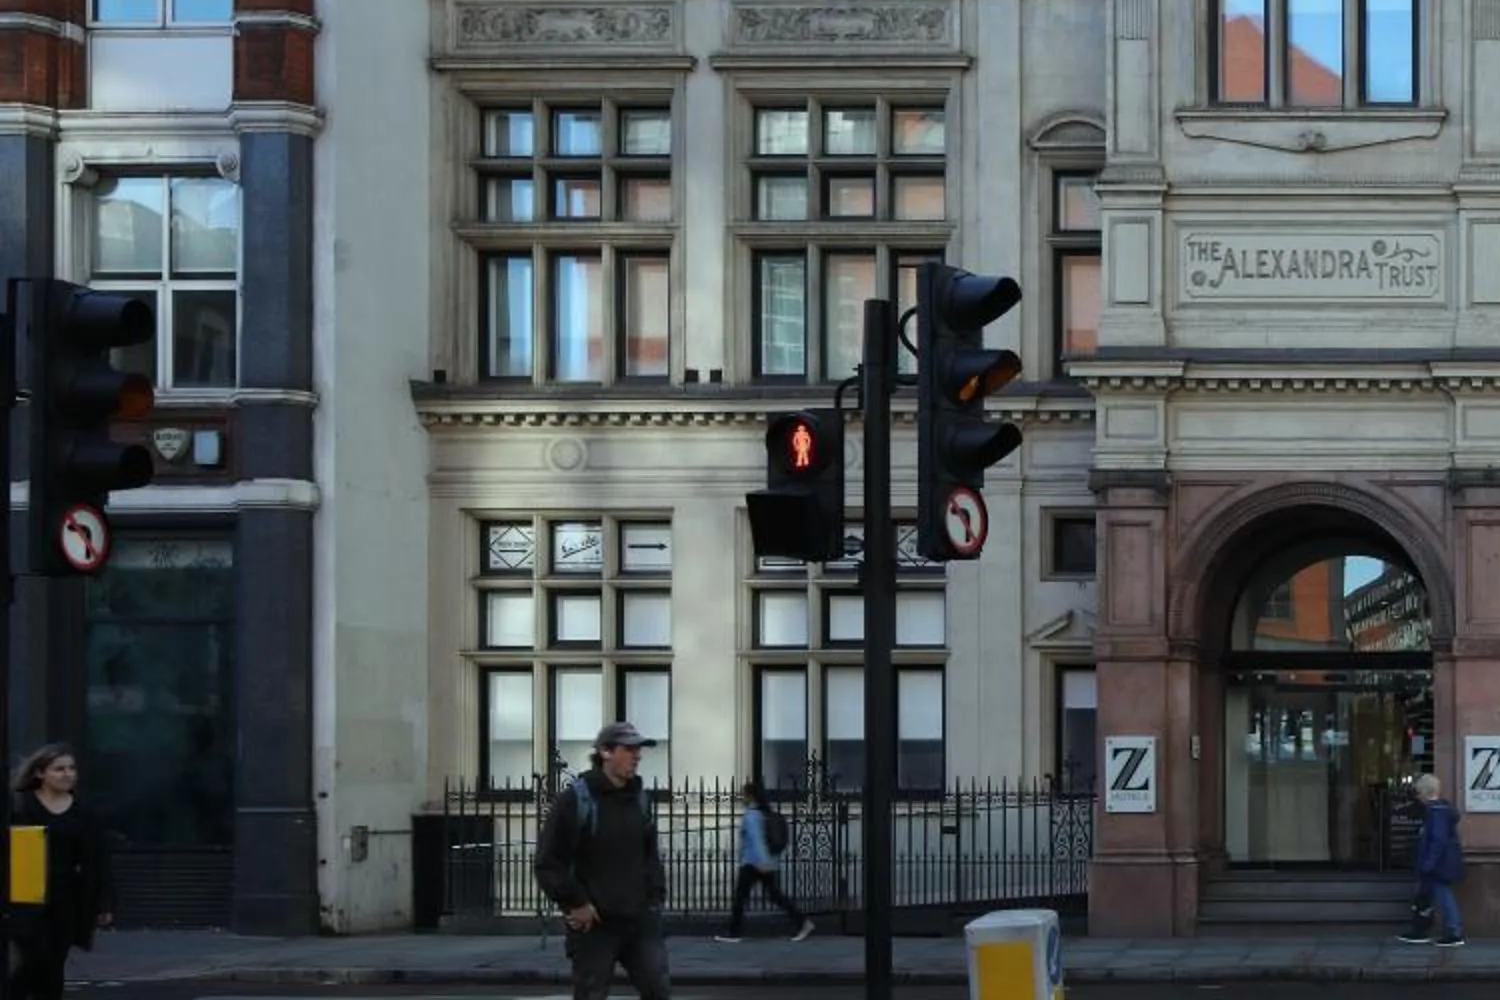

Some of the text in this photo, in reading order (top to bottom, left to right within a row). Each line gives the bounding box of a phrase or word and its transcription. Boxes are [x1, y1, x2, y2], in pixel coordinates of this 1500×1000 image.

[1187, 241, 1437, 289] THE ALEXANDRA TRUST
[1110, 747, 1149, 791] Z
